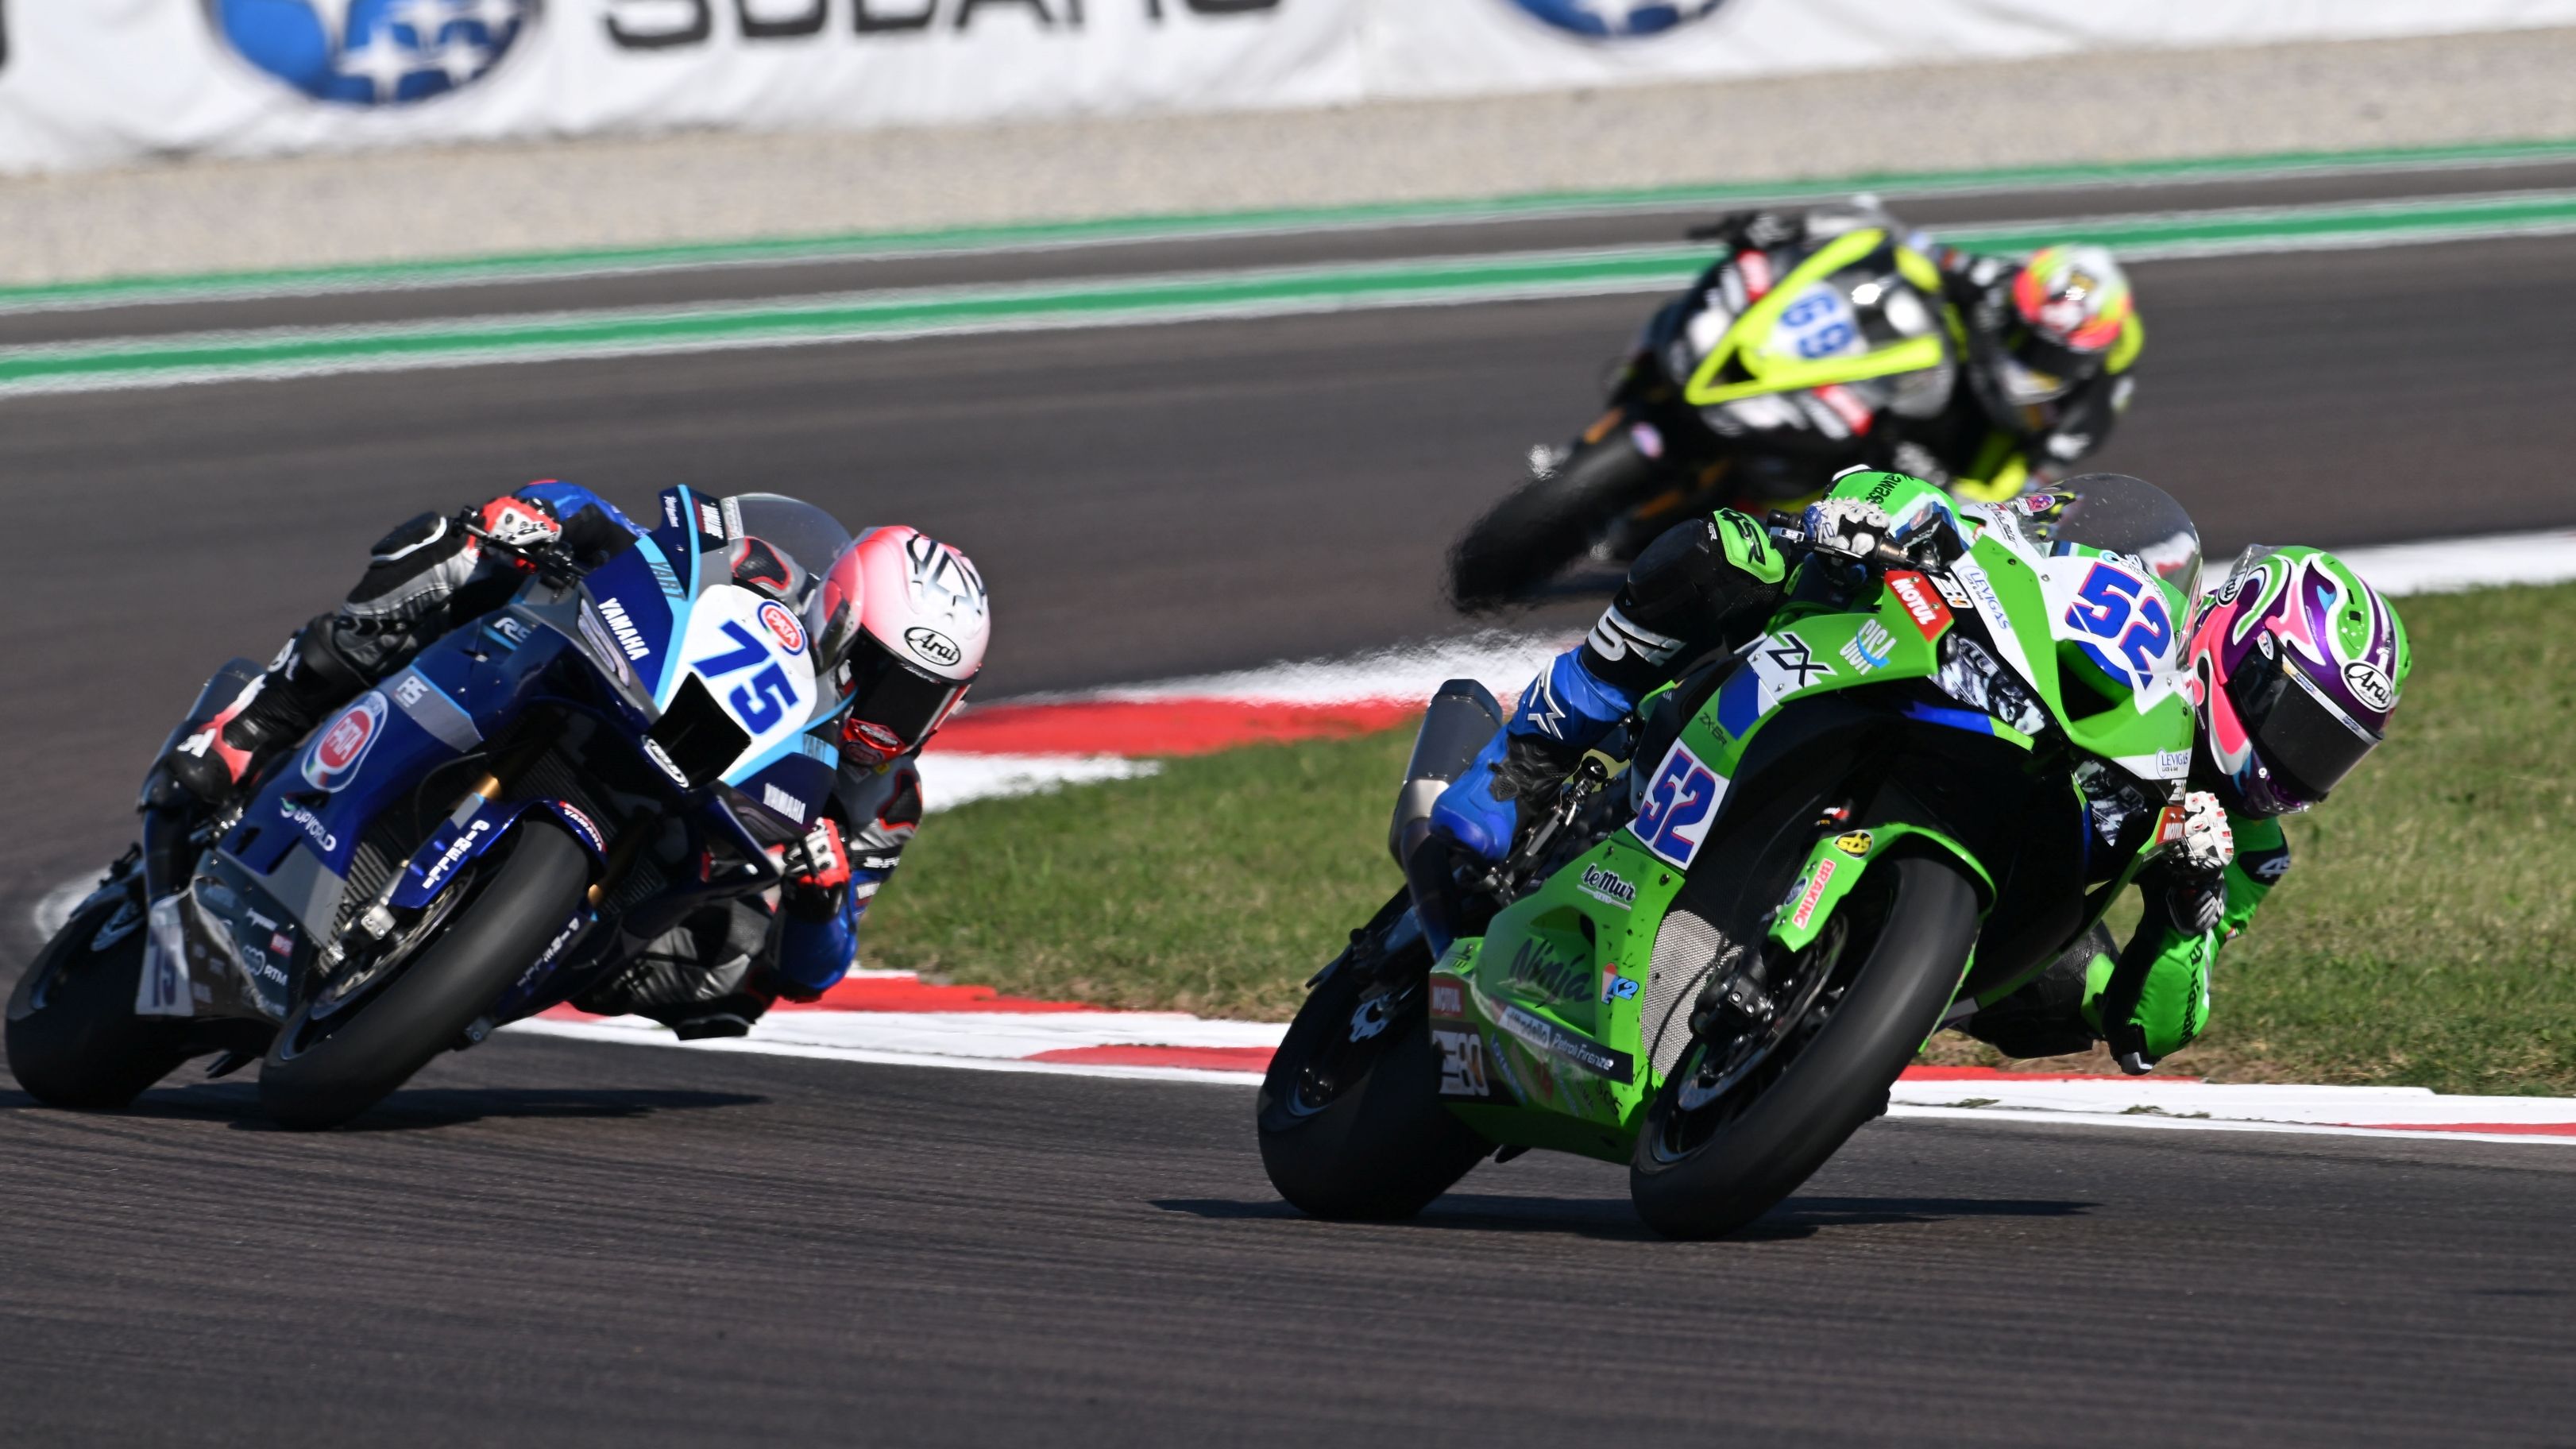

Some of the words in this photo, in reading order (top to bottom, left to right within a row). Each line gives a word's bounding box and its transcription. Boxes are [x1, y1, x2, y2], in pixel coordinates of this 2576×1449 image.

[1782, 292, 1856, 359] 69
[597, 597, 650, 661] YAMAHA
[766, 610, 798, 646] PATA
[1890, 578, 1937, 625] MOTUL
[1970, 572, 2010, 630] LEVIGAS
[2065, 561, 2172, 691] 52
[689, 618, 801, 736] 75
[908, 633, 956, 661] Arai
[1765, 634, 1831, 689] ZX
[2346, 670, 2391, 705] Arai
[326, 716, 364, 761] PATA
[564, 808, 603, 852] YAMAHA
[1633, 747, 1717, 864] 52
[422, 819, 490, 890] PIRELLI
[1794, 858, 1836, 929] BRAKING
[516, 917, 580, 987] PIRELLI
[1510, 937, 1594, 1009] Ninja
